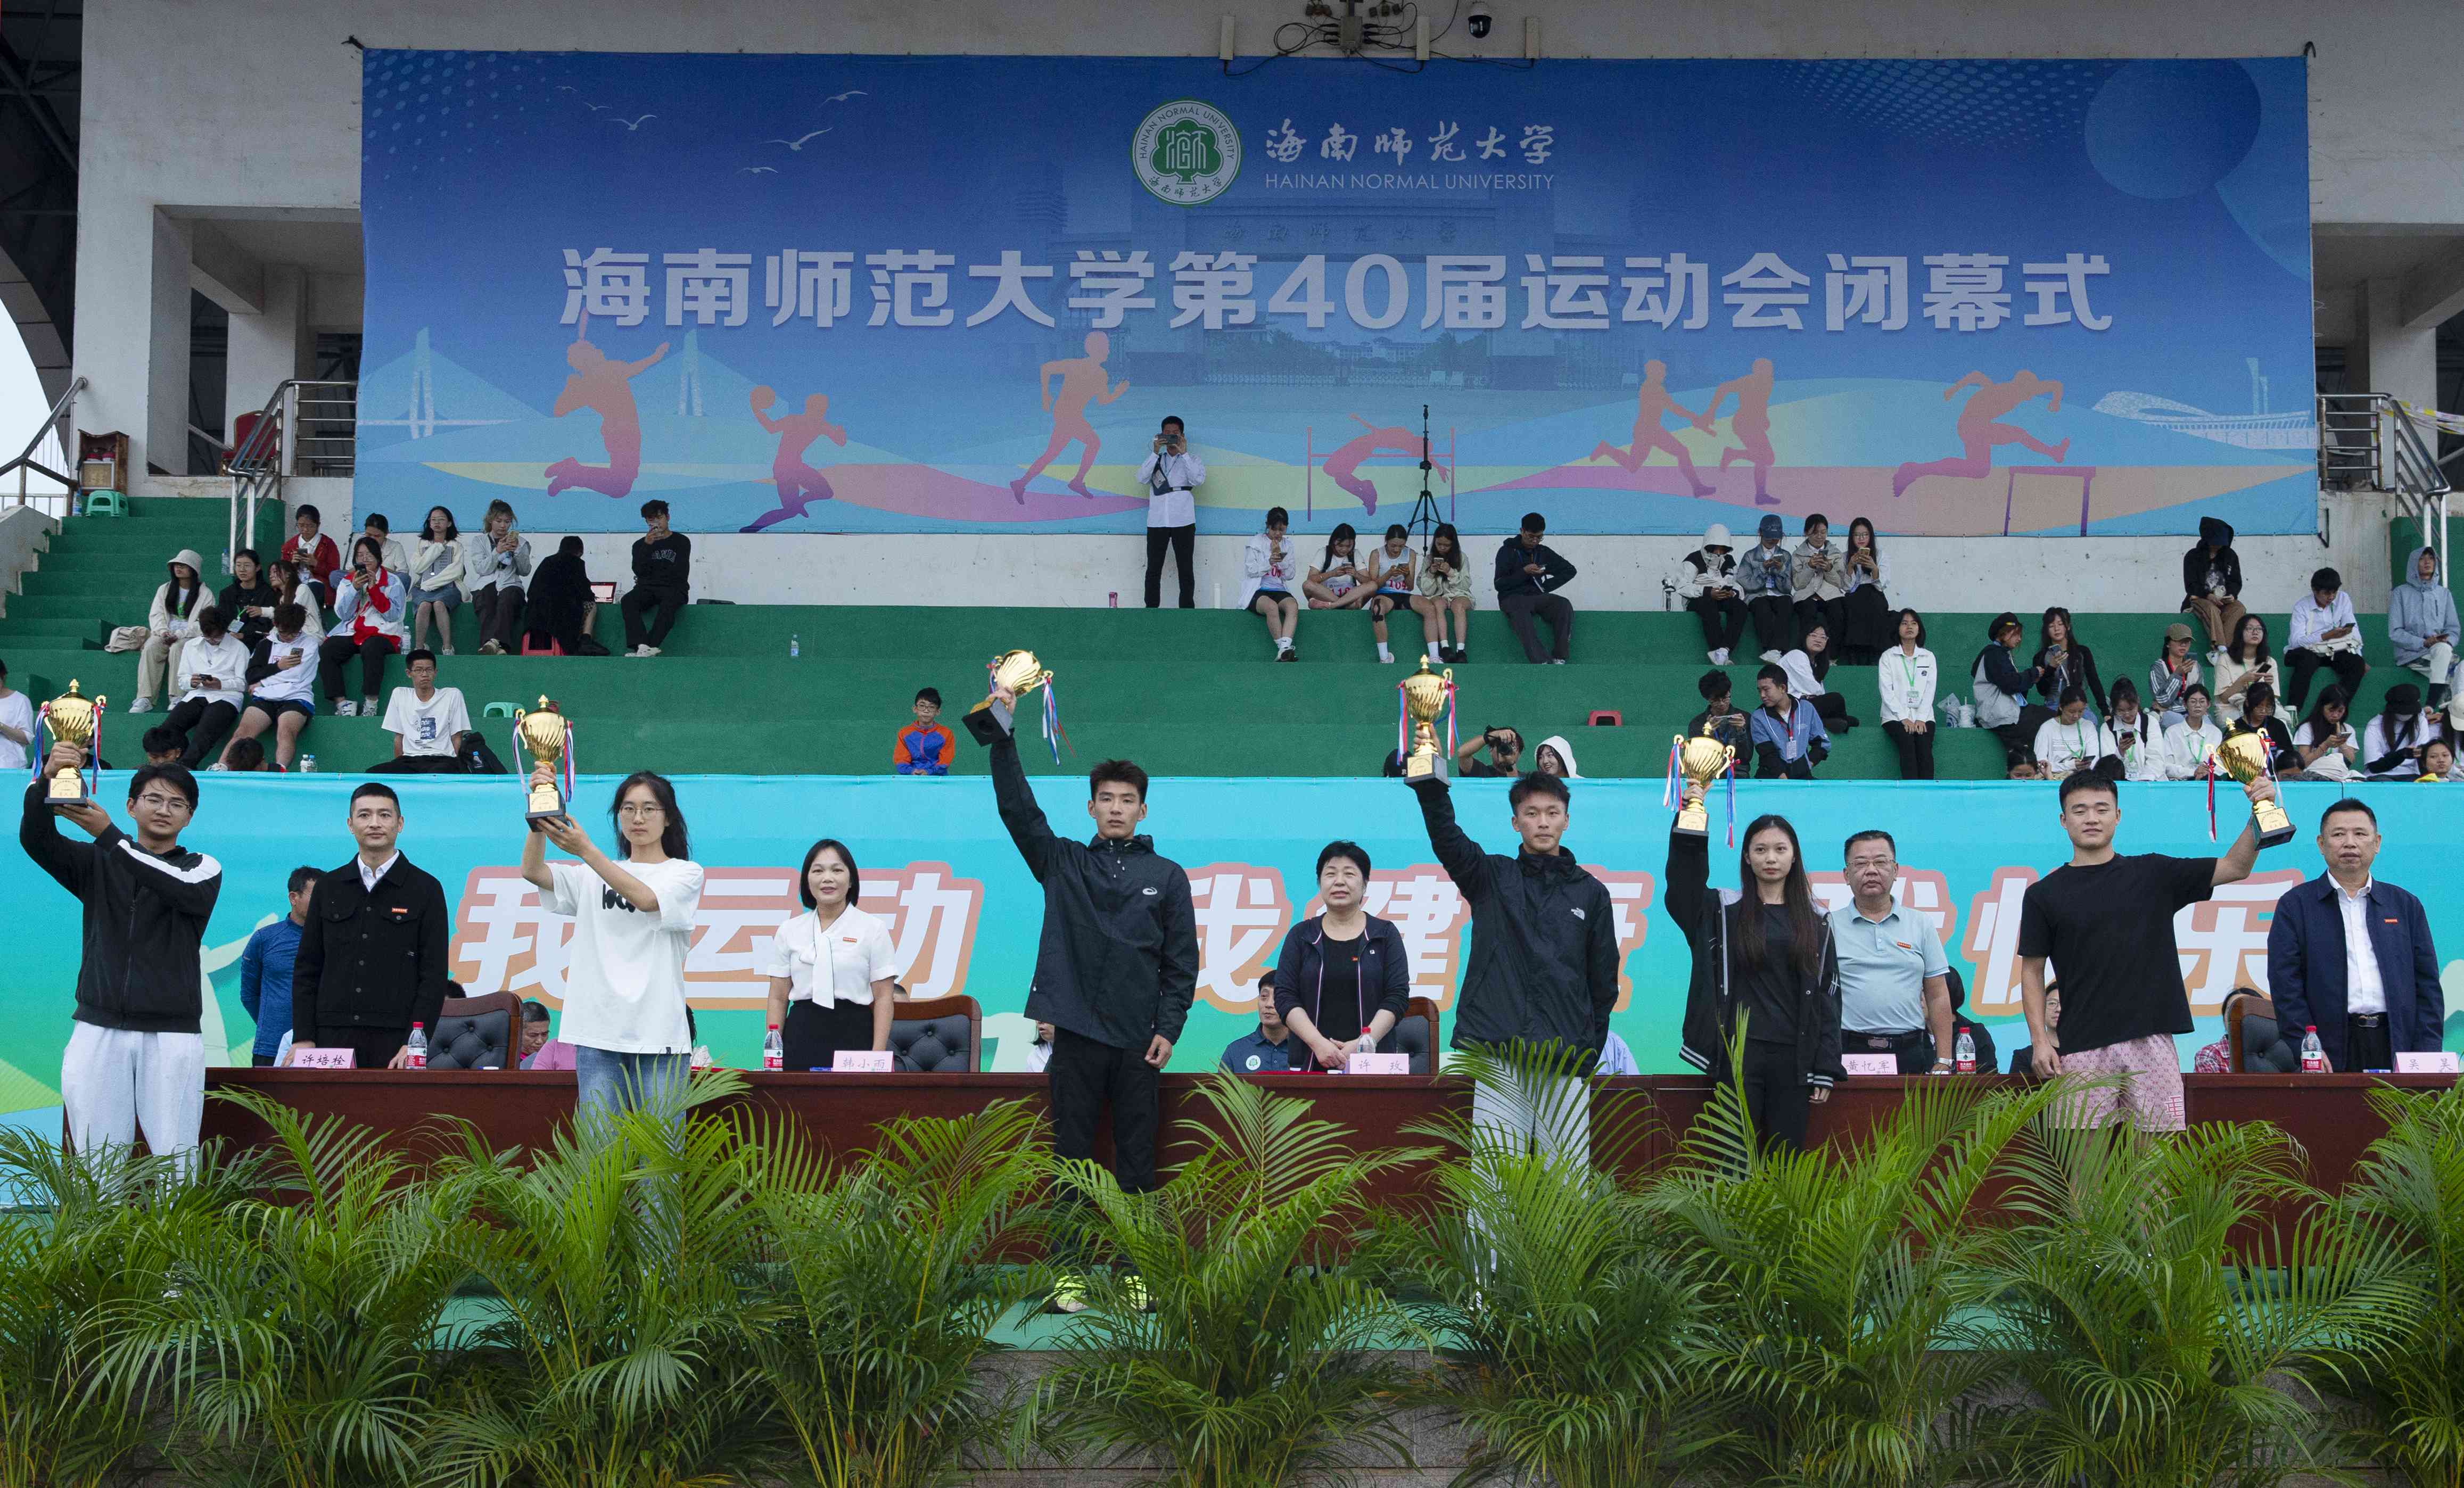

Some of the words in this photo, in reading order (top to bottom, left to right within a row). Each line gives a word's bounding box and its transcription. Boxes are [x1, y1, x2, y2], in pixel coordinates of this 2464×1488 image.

[1139, 121, 1158, 159] HAINAN
[1157, 106, 1200, 122] NORMAL
[1203, 110, 1235, 160] UNIVERSITY
[1265, 118, 1554, 166] 海南师范大学
[1265, 173, 1345, 189] HAINAN
[1350, 173, 1439, 189] NORMAL
[1445, 173, 1555, 189] UNIVERSITY
[561, 247, 2113, 331] 海南师范大学第40届运动会闭幕式
[843, 1056, 885, 1069] 韩小雨
